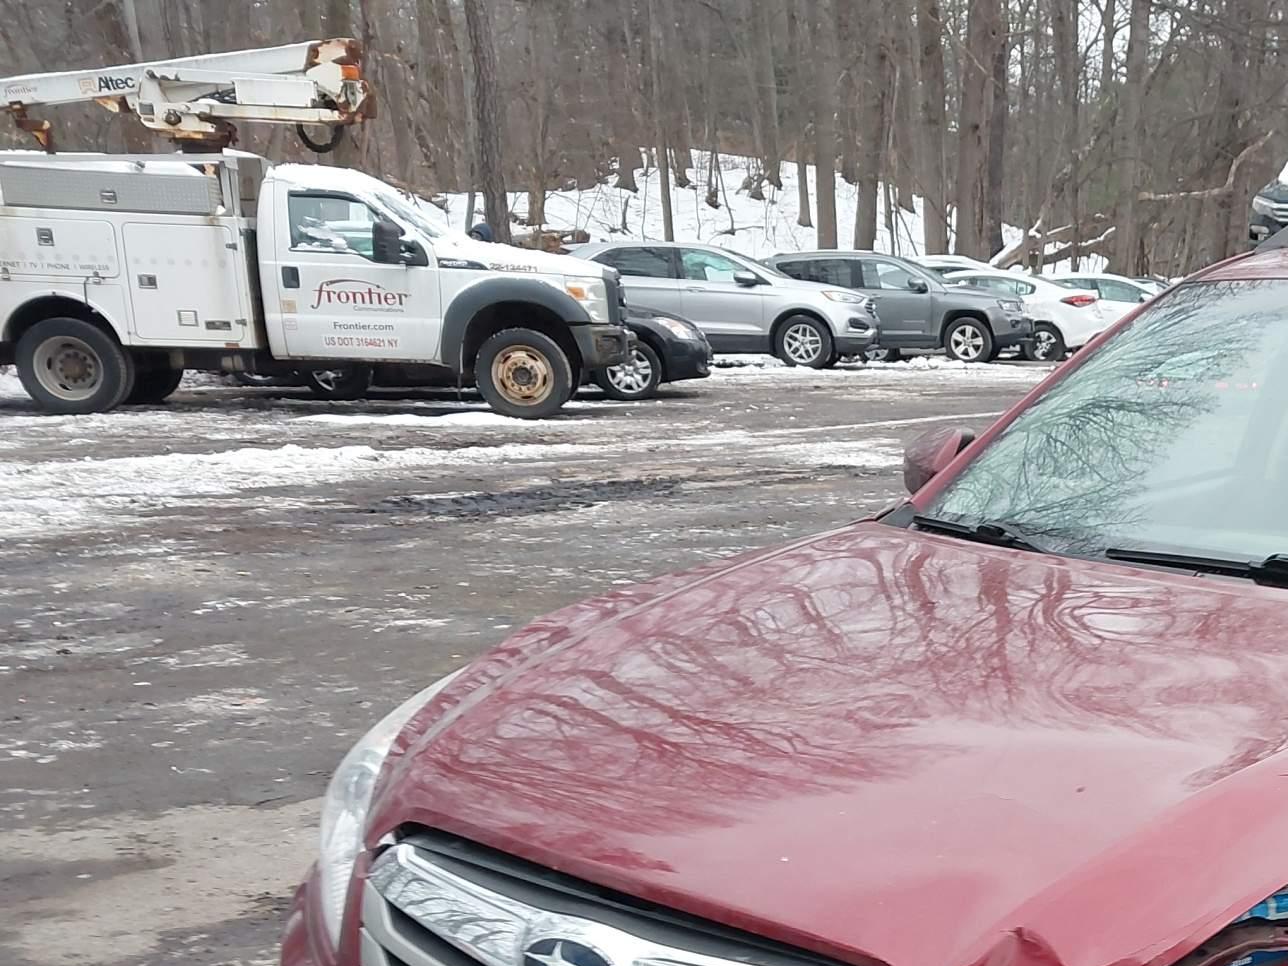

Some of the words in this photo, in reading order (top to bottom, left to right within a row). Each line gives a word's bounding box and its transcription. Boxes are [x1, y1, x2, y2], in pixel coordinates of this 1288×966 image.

[98, 76, 136, 92] Altec
[310, 279, 409, 310] frontier
[353, 305, 405, 313] Communications
[333, 321, 395, 331] Frontier.com
[324, 336, 337, 346] US
[337, 336, 354, 346] DOT
[387, 338, 399, 348] NY
